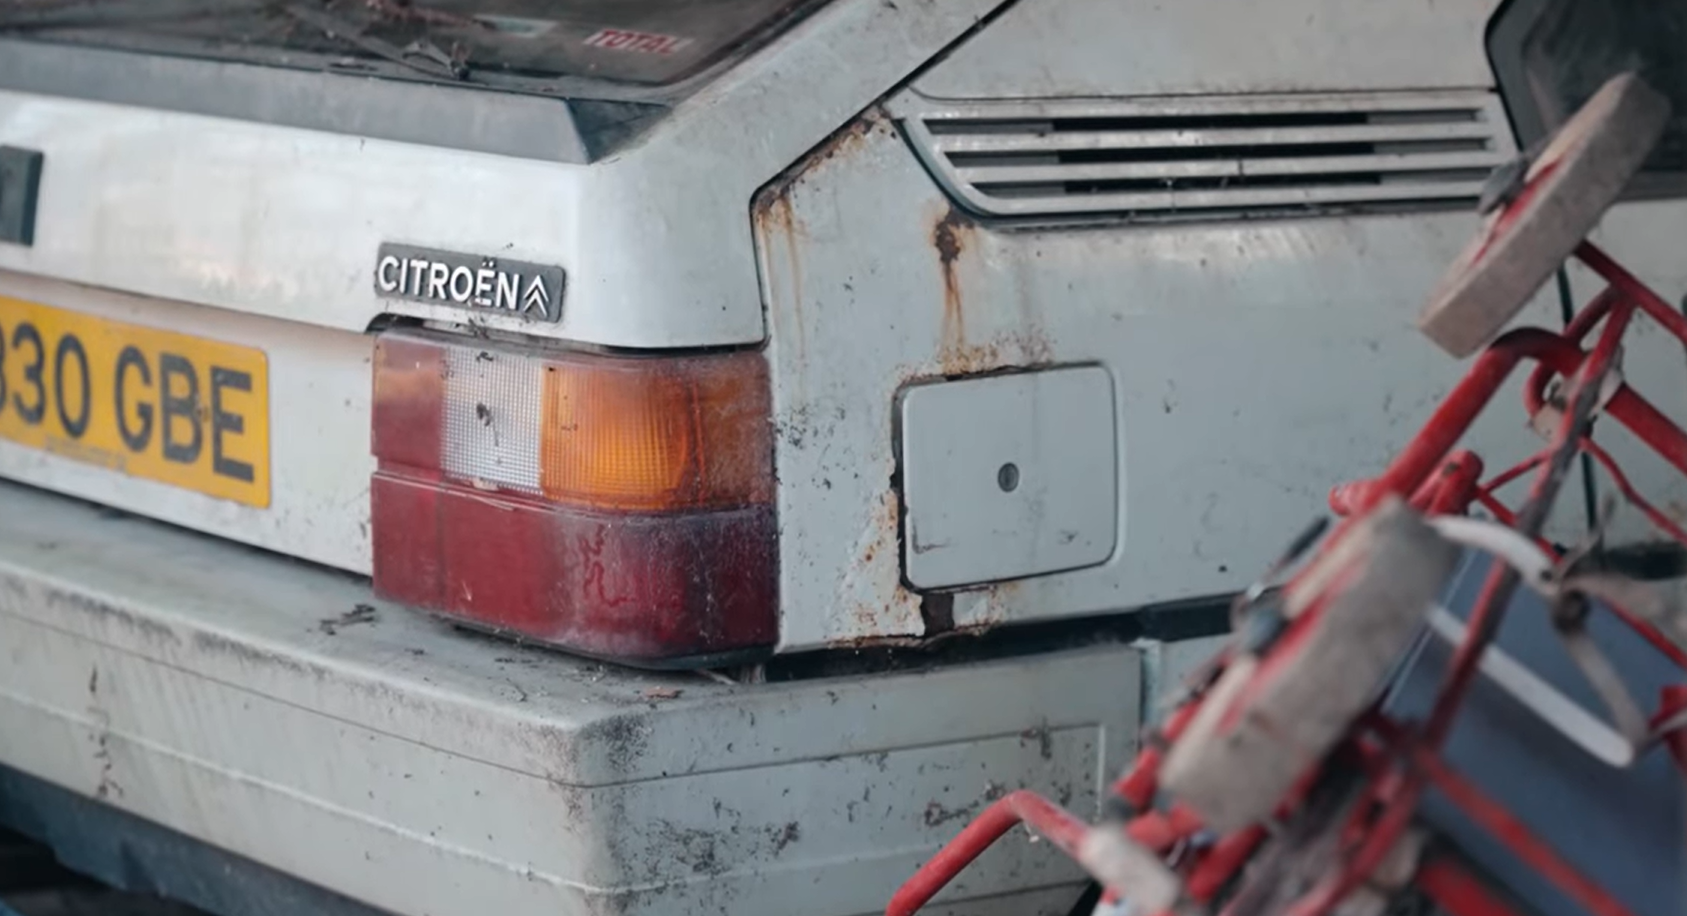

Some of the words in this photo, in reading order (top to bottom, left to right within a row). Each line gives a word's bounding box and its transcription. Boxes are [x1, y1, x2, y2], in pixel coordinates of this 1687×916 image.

[590, 28, 679, 55] TOTAL
[378, 255, 519, 310] CITROËN
[115, 345, 254, 483] GBE
